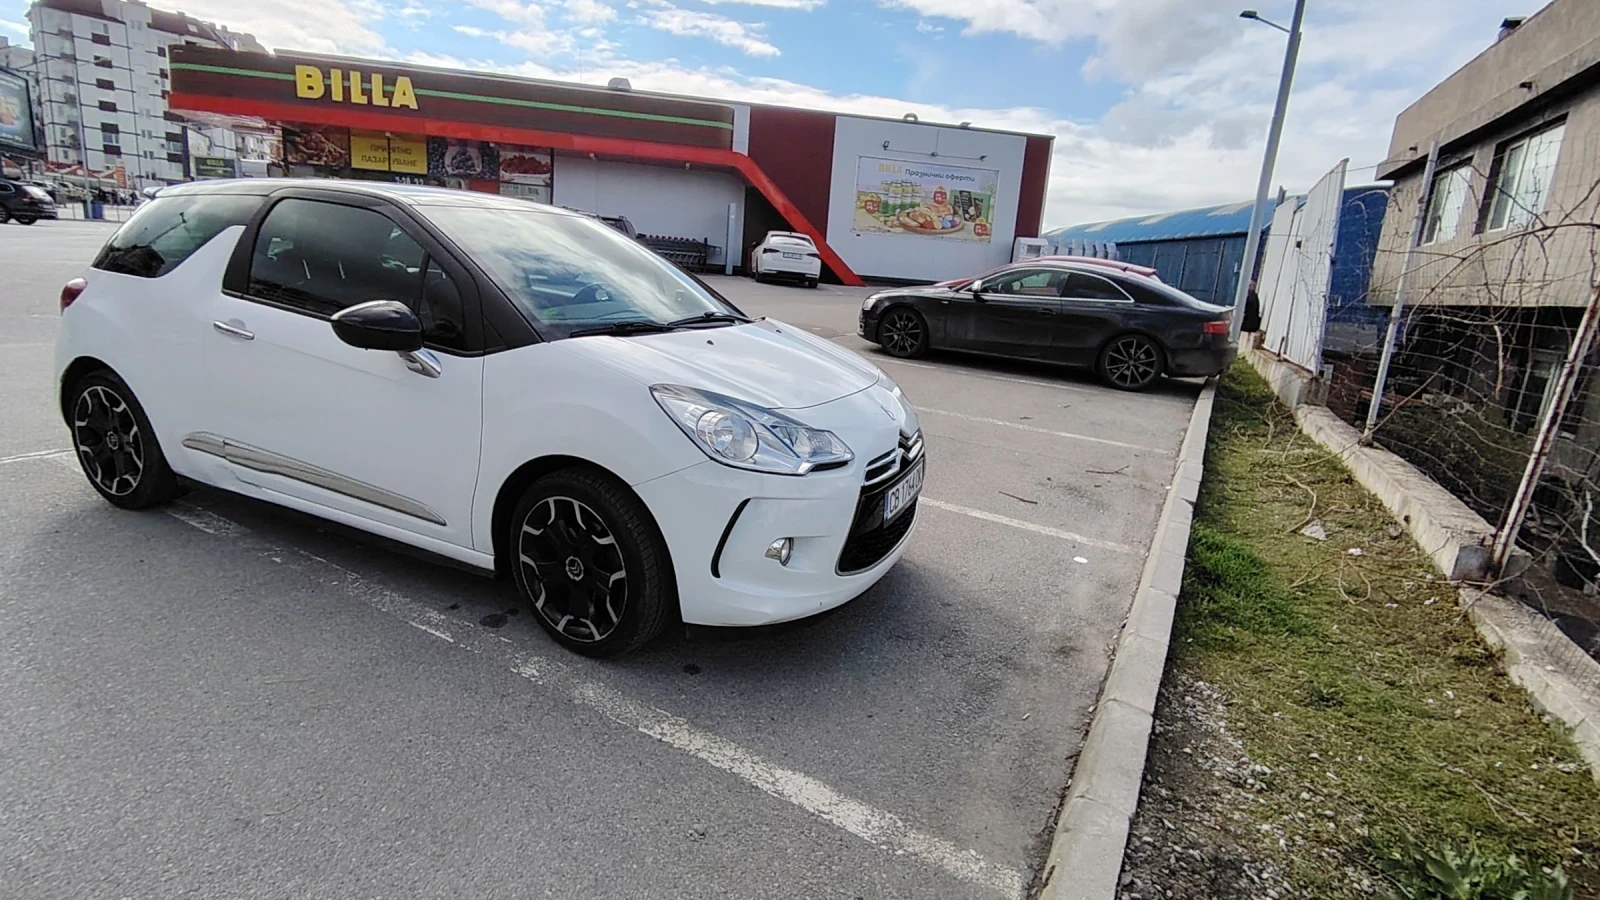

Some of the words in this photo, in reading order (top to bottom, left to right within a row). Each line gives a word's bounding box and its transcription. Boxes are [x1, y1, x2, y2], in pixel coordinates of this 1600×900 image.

[295, 64, 419, 110] BILLA
[878, 163, 903, 174] BILLA
[905, 168, 944, 179] Празнички
[945, 173, 975, 182] оферти
